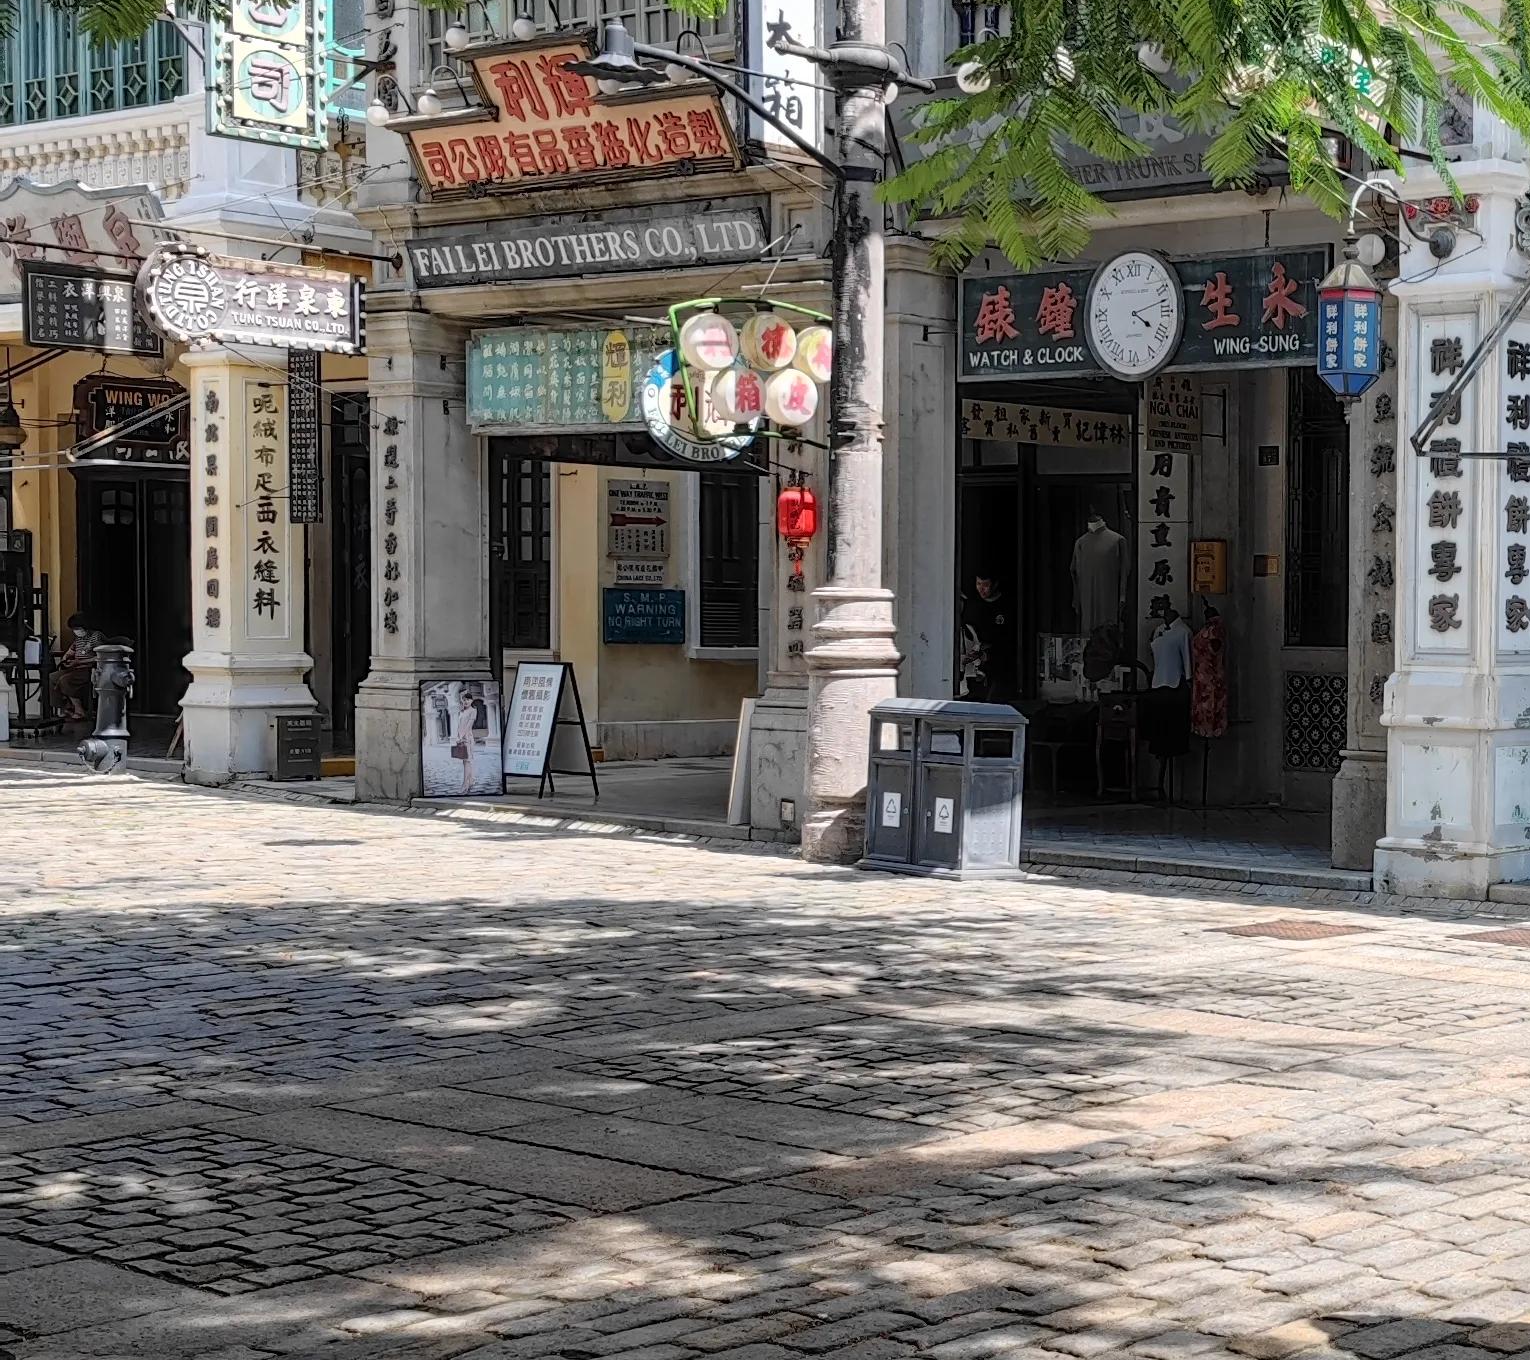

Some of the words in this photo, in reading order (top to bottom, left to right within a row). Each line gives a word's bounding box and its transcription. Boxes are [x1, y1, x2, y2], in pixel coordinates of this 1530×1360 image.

[1111, 155, 1182, 183] TRUNK
[413, 246, 456, 277] FAI
[456, 242, 501, 274] LEI
[501, 228, 641, 270] BROTHERS
[698, 219, 765, 254] LTD.
[232, 278, 349, 319] 東泉洋行
[1200, 261, 1308, 332] 永生
[232, 311, 263, 325] TUNG
[265, 316, 302, 330] TSUAN
[969, 350, 1018, 368] WATCH
[1022, 350, 1034, 366] &
[1037, 346, 1084, 365] CLOCK
[1213, 337, 1251, 356] WING
[1256, 333, 1301, 353] SUNG
[105, 390, 143, 406] WING
[608, 616, 622, 627] NO
[625, 616, 653, 628] RIGHT
[656, 616, 682, 628] TURN
[615, 604, 677, 615] WARNING
